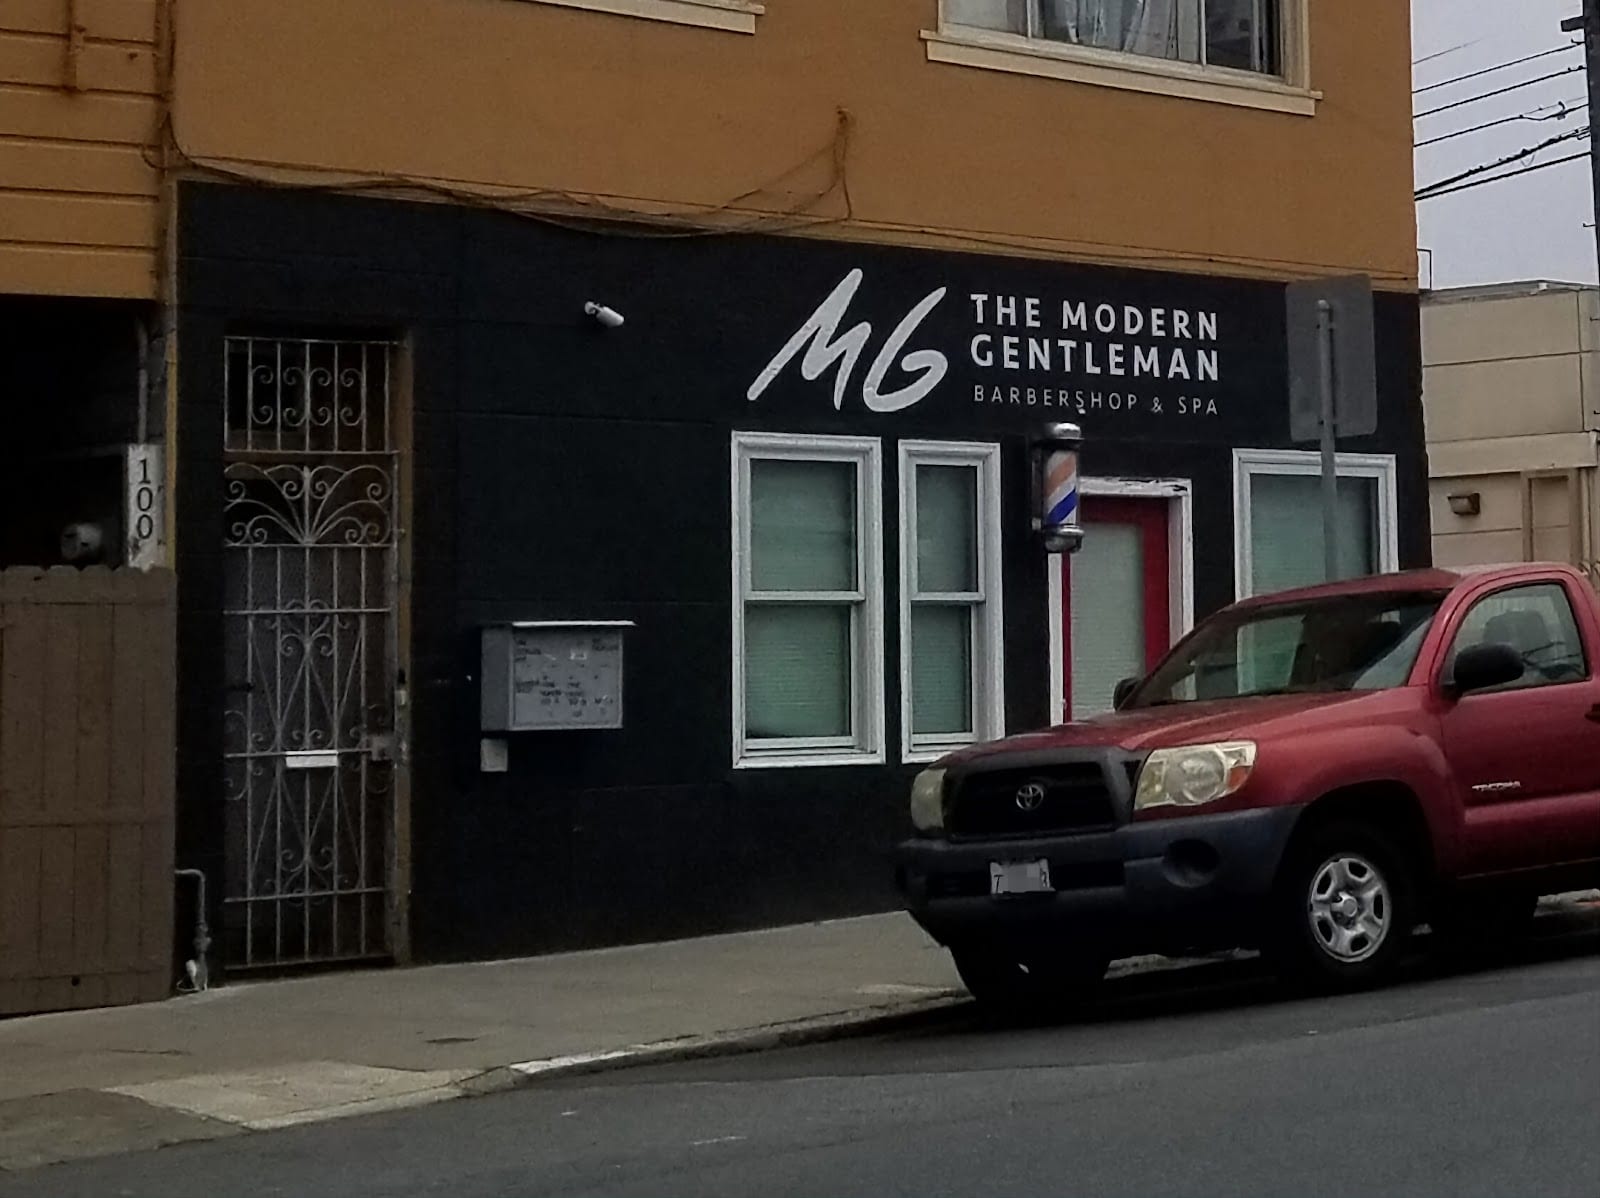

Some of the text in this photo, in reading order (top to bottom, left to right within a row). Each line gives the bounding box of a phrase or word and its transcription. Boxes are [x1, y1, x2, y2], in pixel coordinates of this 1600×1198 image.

[970, 293, 1218, 341] THE MODERN
[970, 333, 1218, 381] GENTLEMAN
[974, 384, 1219, 415] BARBERSHOP & SPA
[137, 458, 153, 540] 100
